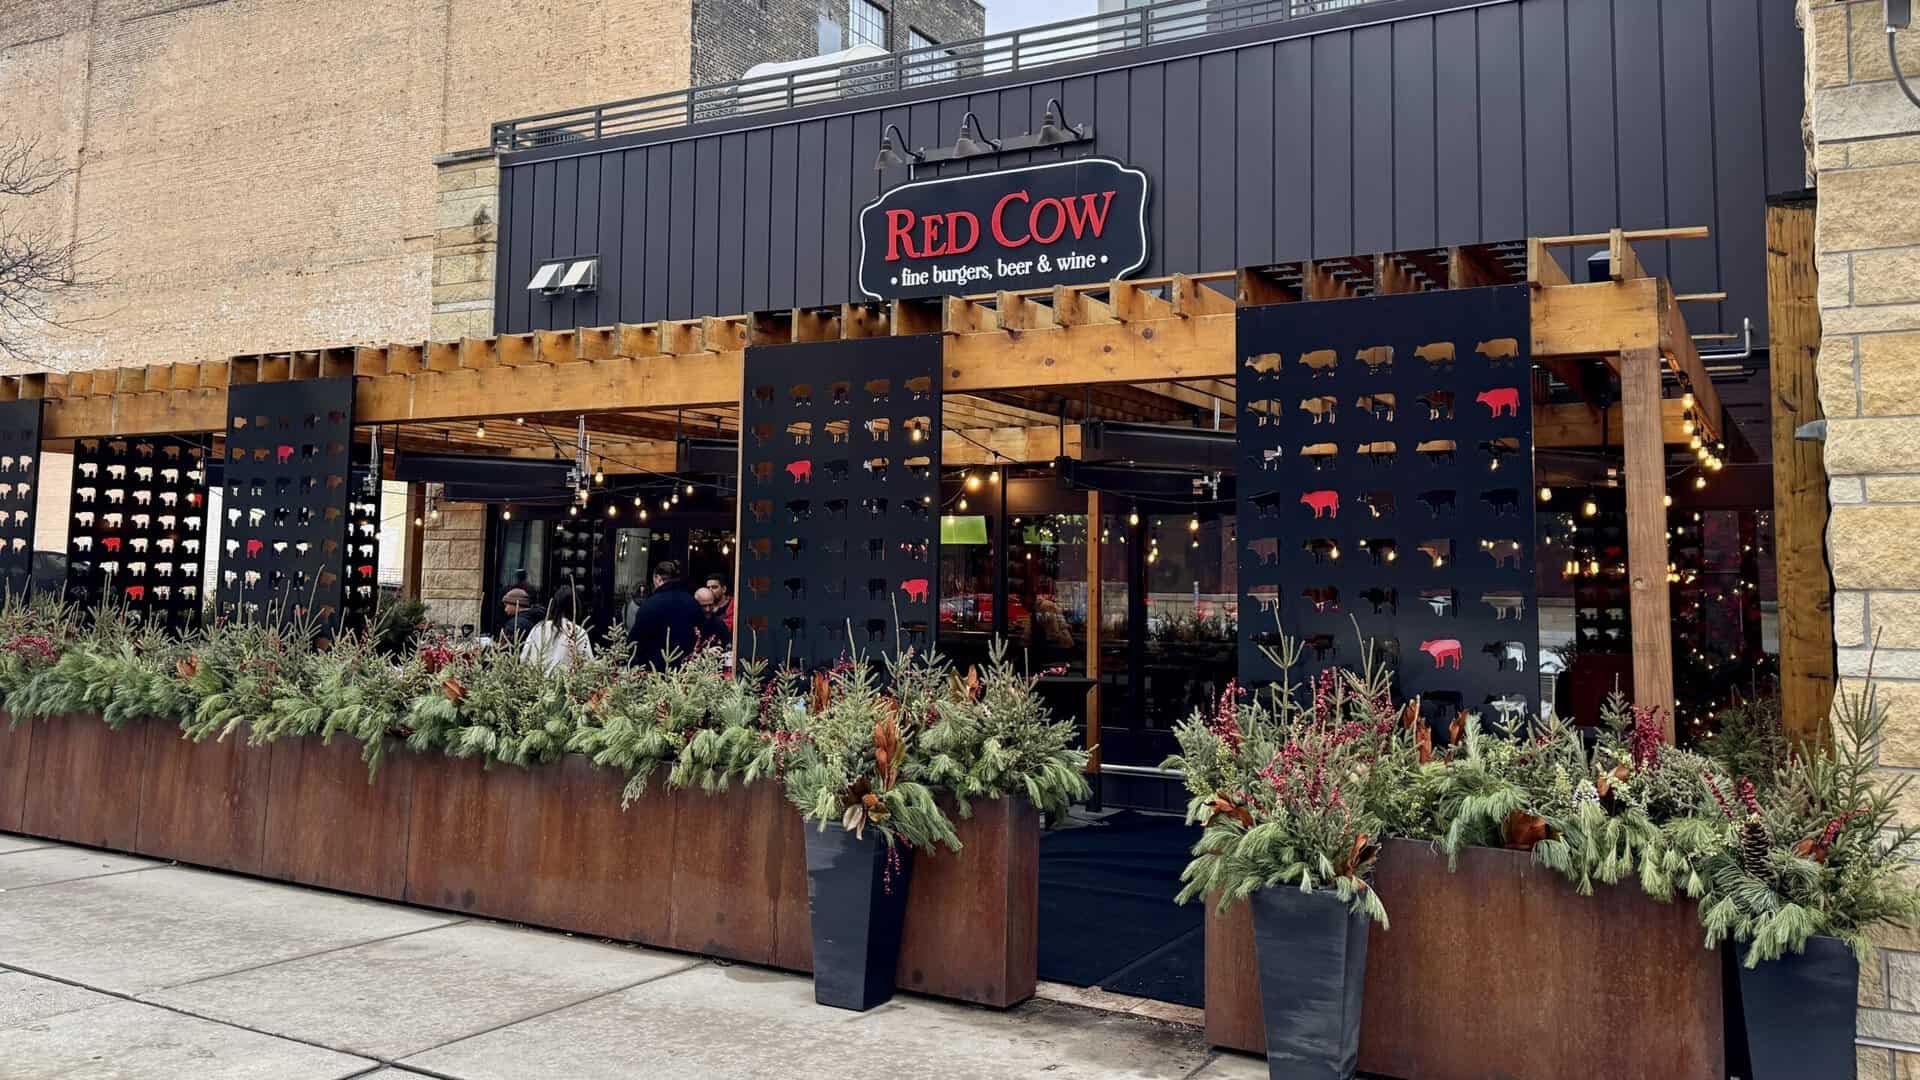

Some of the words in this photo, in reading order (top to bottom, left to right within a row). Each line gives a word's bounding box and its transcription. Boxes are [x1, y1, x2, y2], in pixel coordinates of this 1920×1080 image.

[884, 208, 981, 262] RED
[990, 190, 1116, 248] COW
[901, 267, 929, 287] fine
[932, 264, 993, 286] burgers,
[997, 257, 1033, 277] beer
[1036, 253, 1053, 273] &
[1056, 252, 1097, 272] wine
